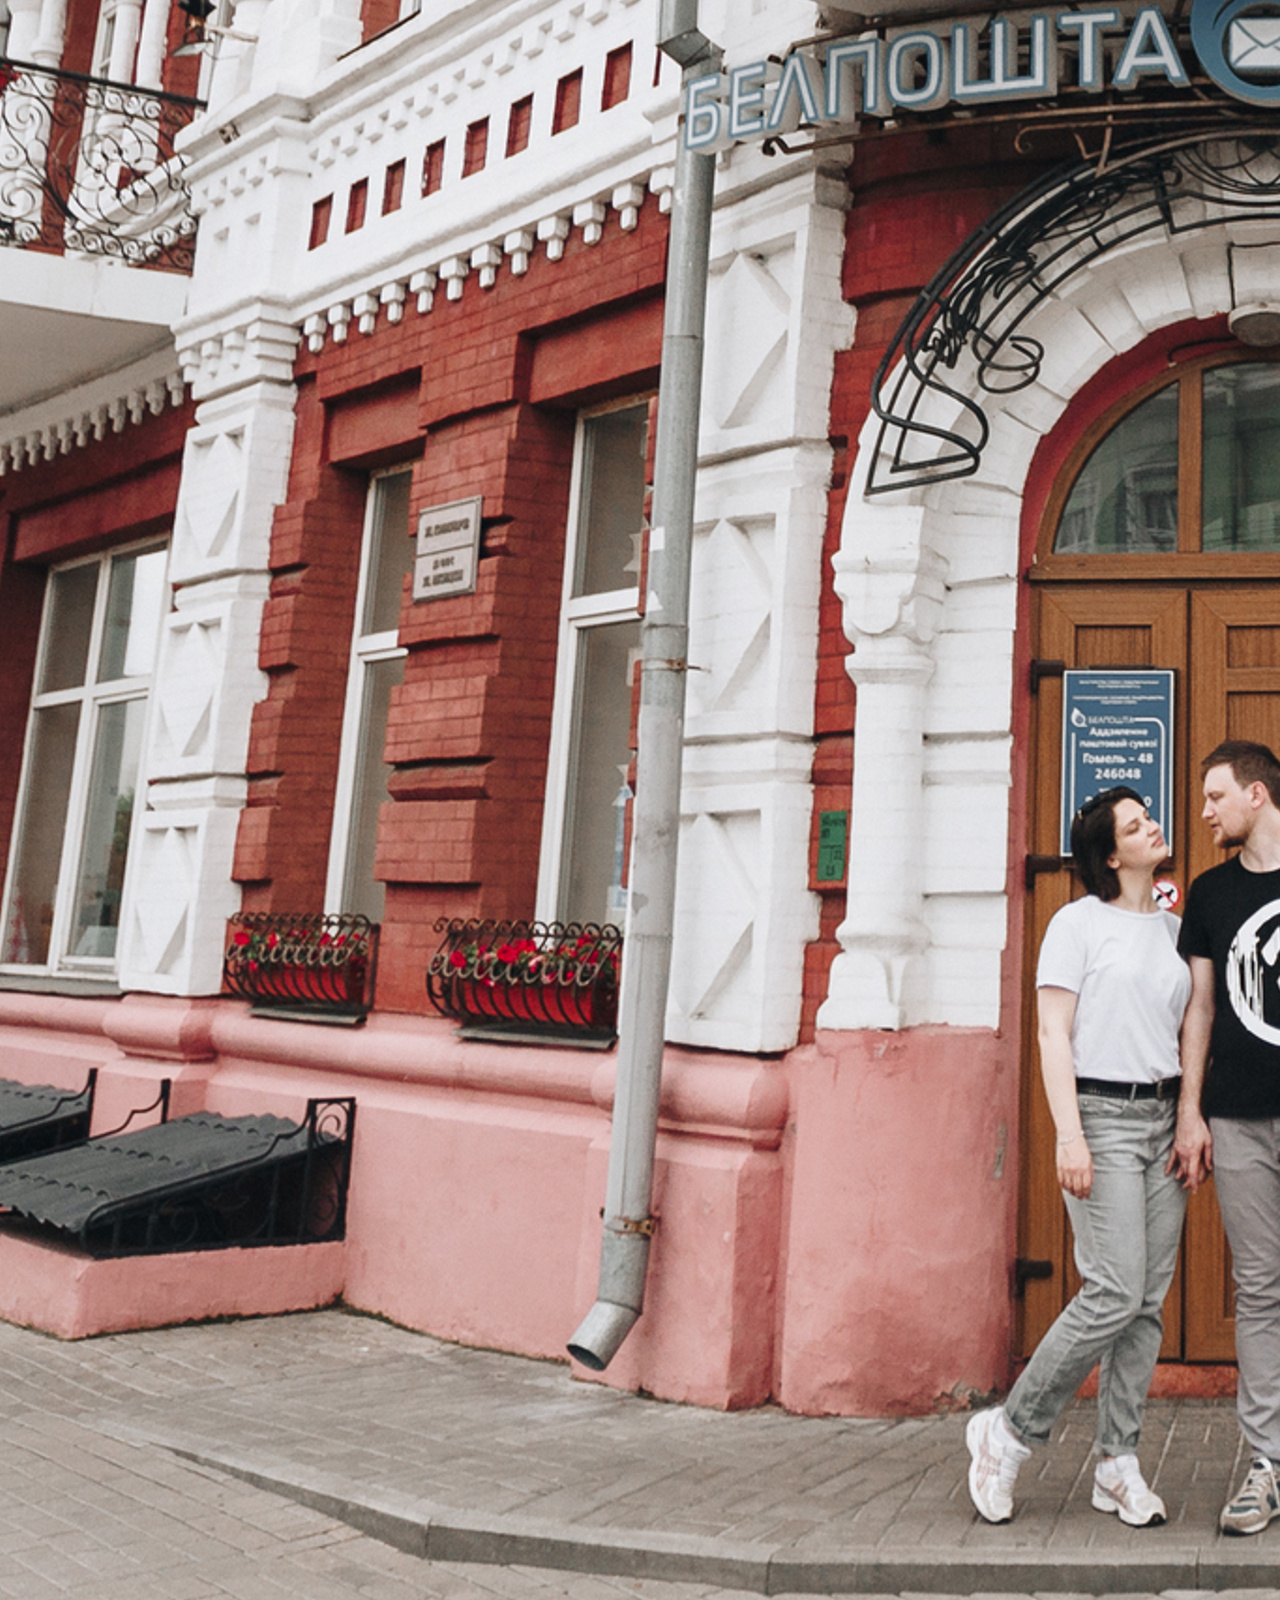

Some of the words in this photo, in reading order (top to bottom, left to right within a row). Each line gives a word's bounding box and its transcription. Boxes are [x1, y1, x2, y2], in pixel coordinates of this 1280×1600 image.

[684, 5, 1189, 150] БЕЛПОШТА
[1082, 752, 1127, 765] Гомель
[1137, 752, 1154, 764] 48
[1094, 767, 1142, 780] 246048
